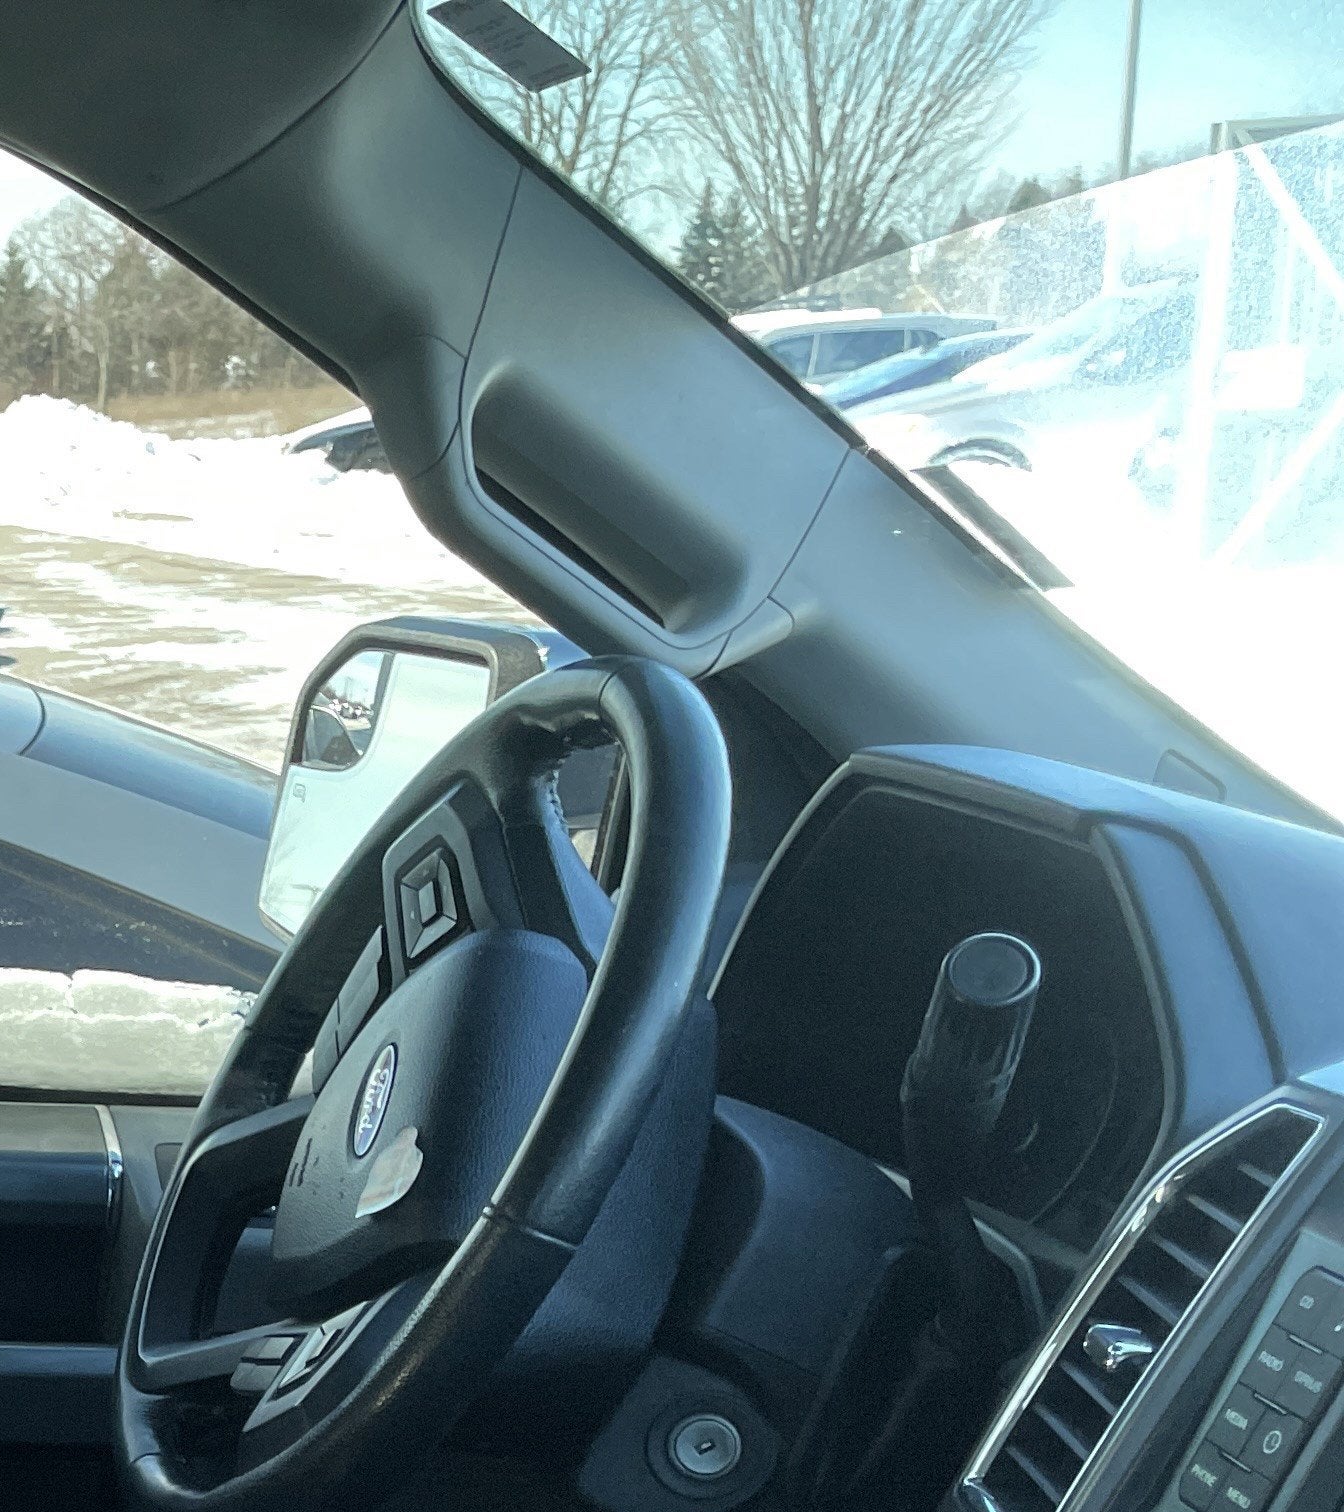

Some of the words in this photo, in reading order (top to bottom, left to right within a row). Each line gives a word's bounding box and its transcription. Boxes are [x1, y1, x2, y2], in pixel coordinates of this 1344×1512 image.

[359, 1068, 390, 1134] Ford
[1259, 1350, 1284, 1371] RADIO
[1225, 1408, 1249, 1430] MEDIA
[1191, 1463, 1218, 1487] PHONE
[1226, 1487, 1251, 1509] MENU
